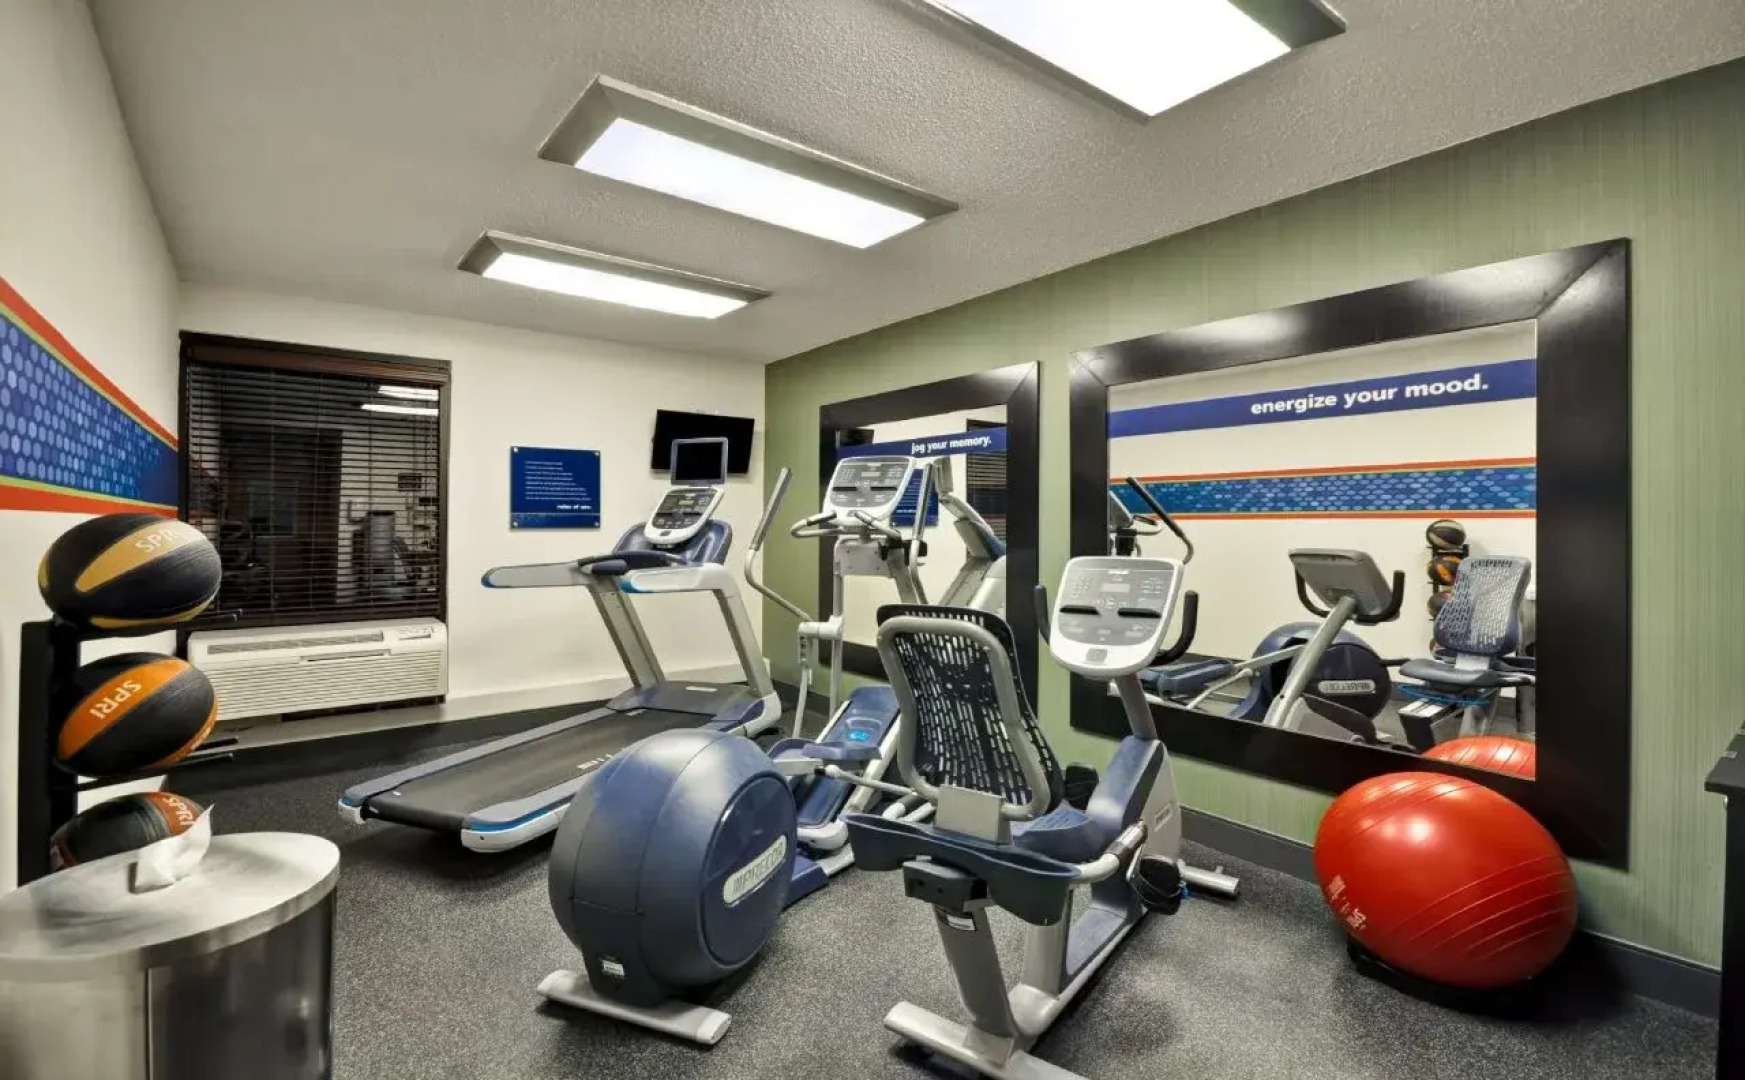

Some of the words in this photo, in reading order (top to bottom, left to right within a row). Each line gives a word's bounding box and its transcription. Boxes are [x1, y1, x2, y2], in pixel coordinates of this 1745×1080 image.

[1250, 394, 1337, 414] energize
[1343, 386, 1398, 409] your
[1405, 373, 1489, 398] mood.
[911, 443, 925, 454] jog
[927, 441, 947, 453] your
[949, 436, 991, 448] memory.
[89, 680, 142, 719] SPRI
